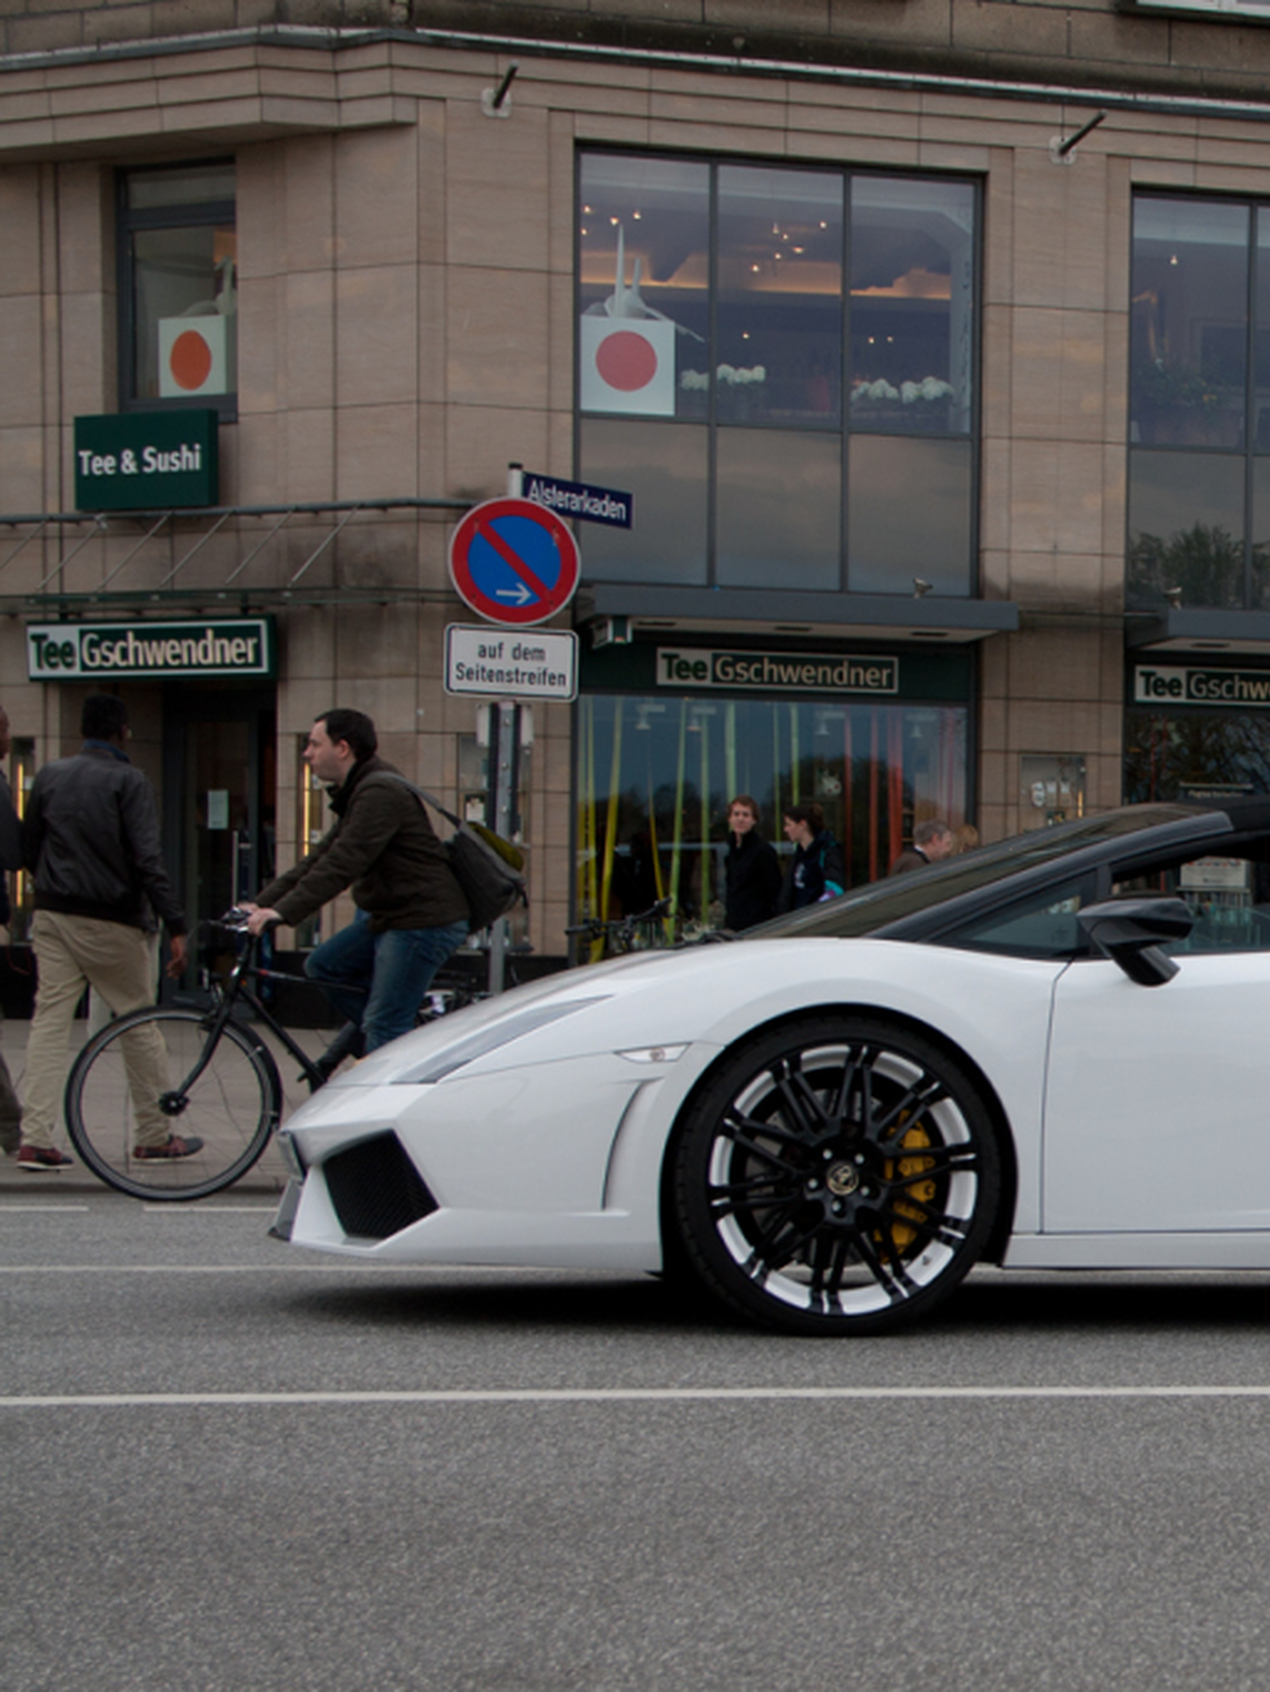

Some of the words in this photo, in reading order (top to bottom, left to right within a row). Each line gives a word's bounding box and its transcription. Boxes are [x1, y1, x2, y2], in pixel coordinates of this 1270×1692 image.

[79, 449, 117, 476] Tee
[120, 448, 138, 475] &
[142, 443, 201, 474] Sushi
[528, 479, 626, 521] Alsterarkaden
[30, 633, 76, 670] Tee
[81, 628, 258, 667] Gschwendner
[478, 641, 504, 659] auf
[511, 642, 546, 662] dem
[455, 661, 567, 687] Seitenstreifen
[660, 653, 708, 681] Tee
[715, 656, 892, 687] Gschwendner
[1139, 670, 1183, 697] Tee
